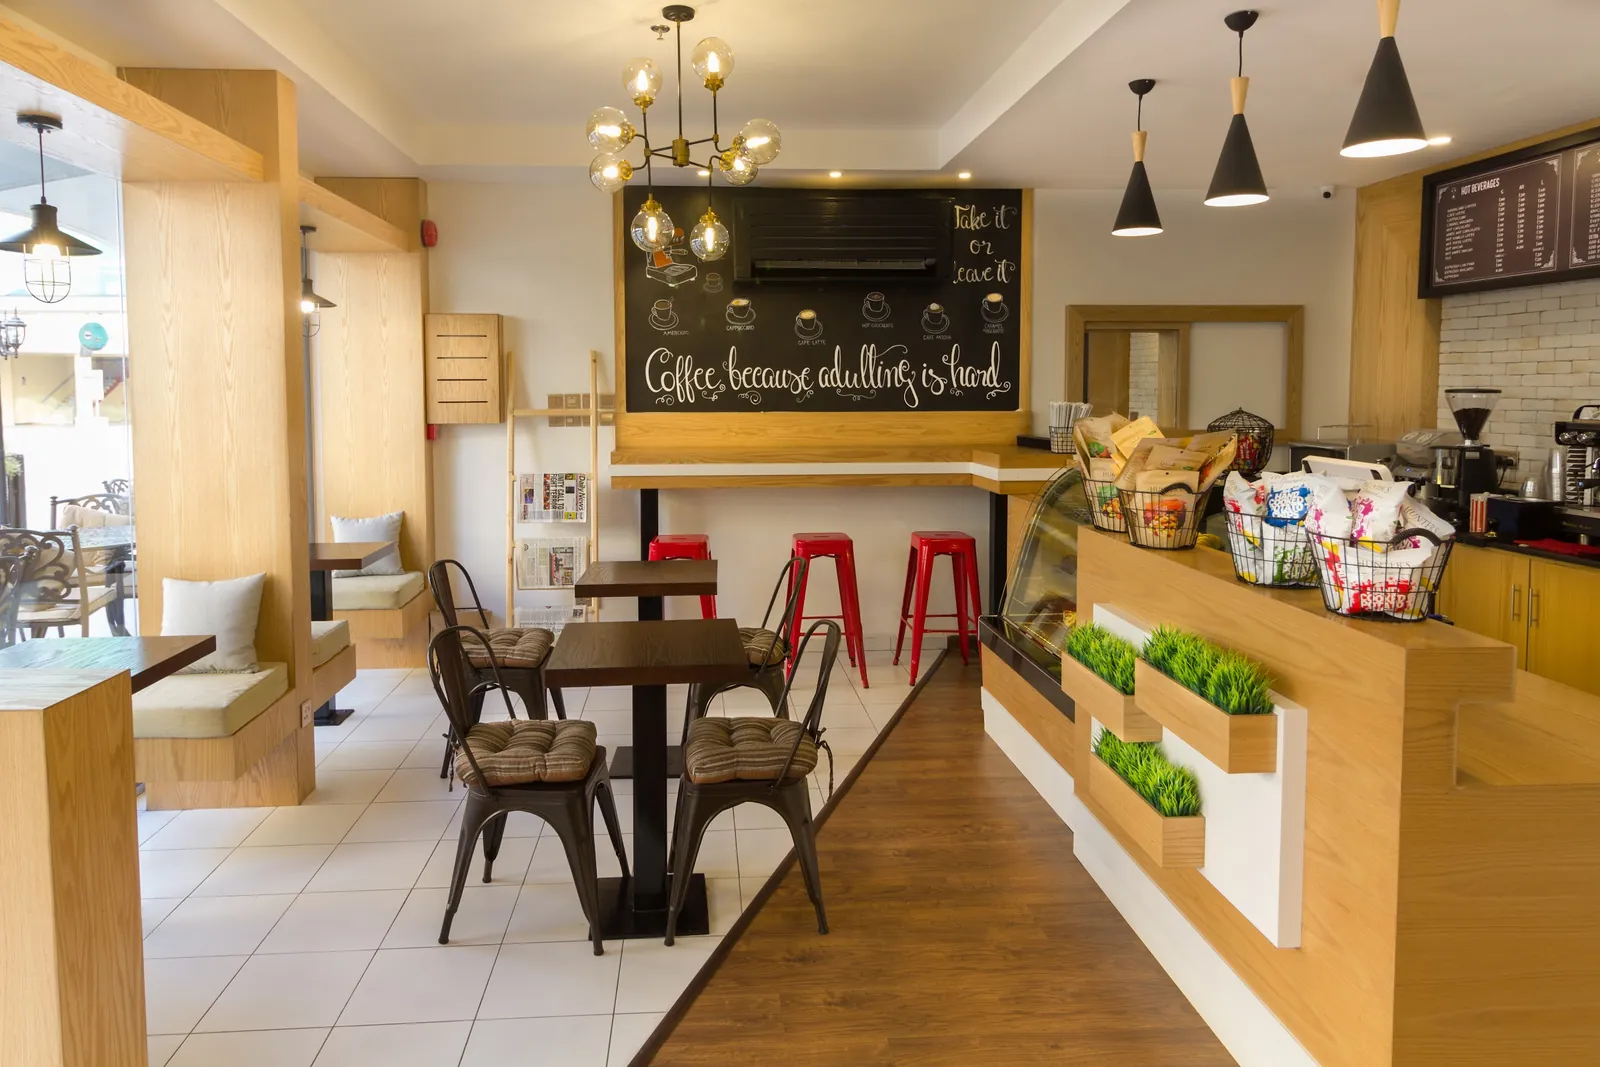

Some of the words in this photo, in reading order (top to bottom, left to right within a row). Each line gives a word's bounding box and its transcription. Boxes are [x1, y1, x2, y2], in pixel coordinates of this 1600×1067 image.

[1461, 185, 1471, 196] HOT
[1471, 178, 1500, 193] BEVERAGES
[954, 204, 992, 231] Take
[992, 204, 1018, 230] it
[970, 239, 994, 255] or
[994, 259, 1016, 284] it
[645, 347, 722, 403] Coffee
[722, 346, 814, 394] because
[818, 344, 917, 408] adulting
[922, 363, 948, 395] is
[942, 341, 1004, 389] hard
[578, 473, 586, 493] Daily
[578, 493, 586, 511] News
